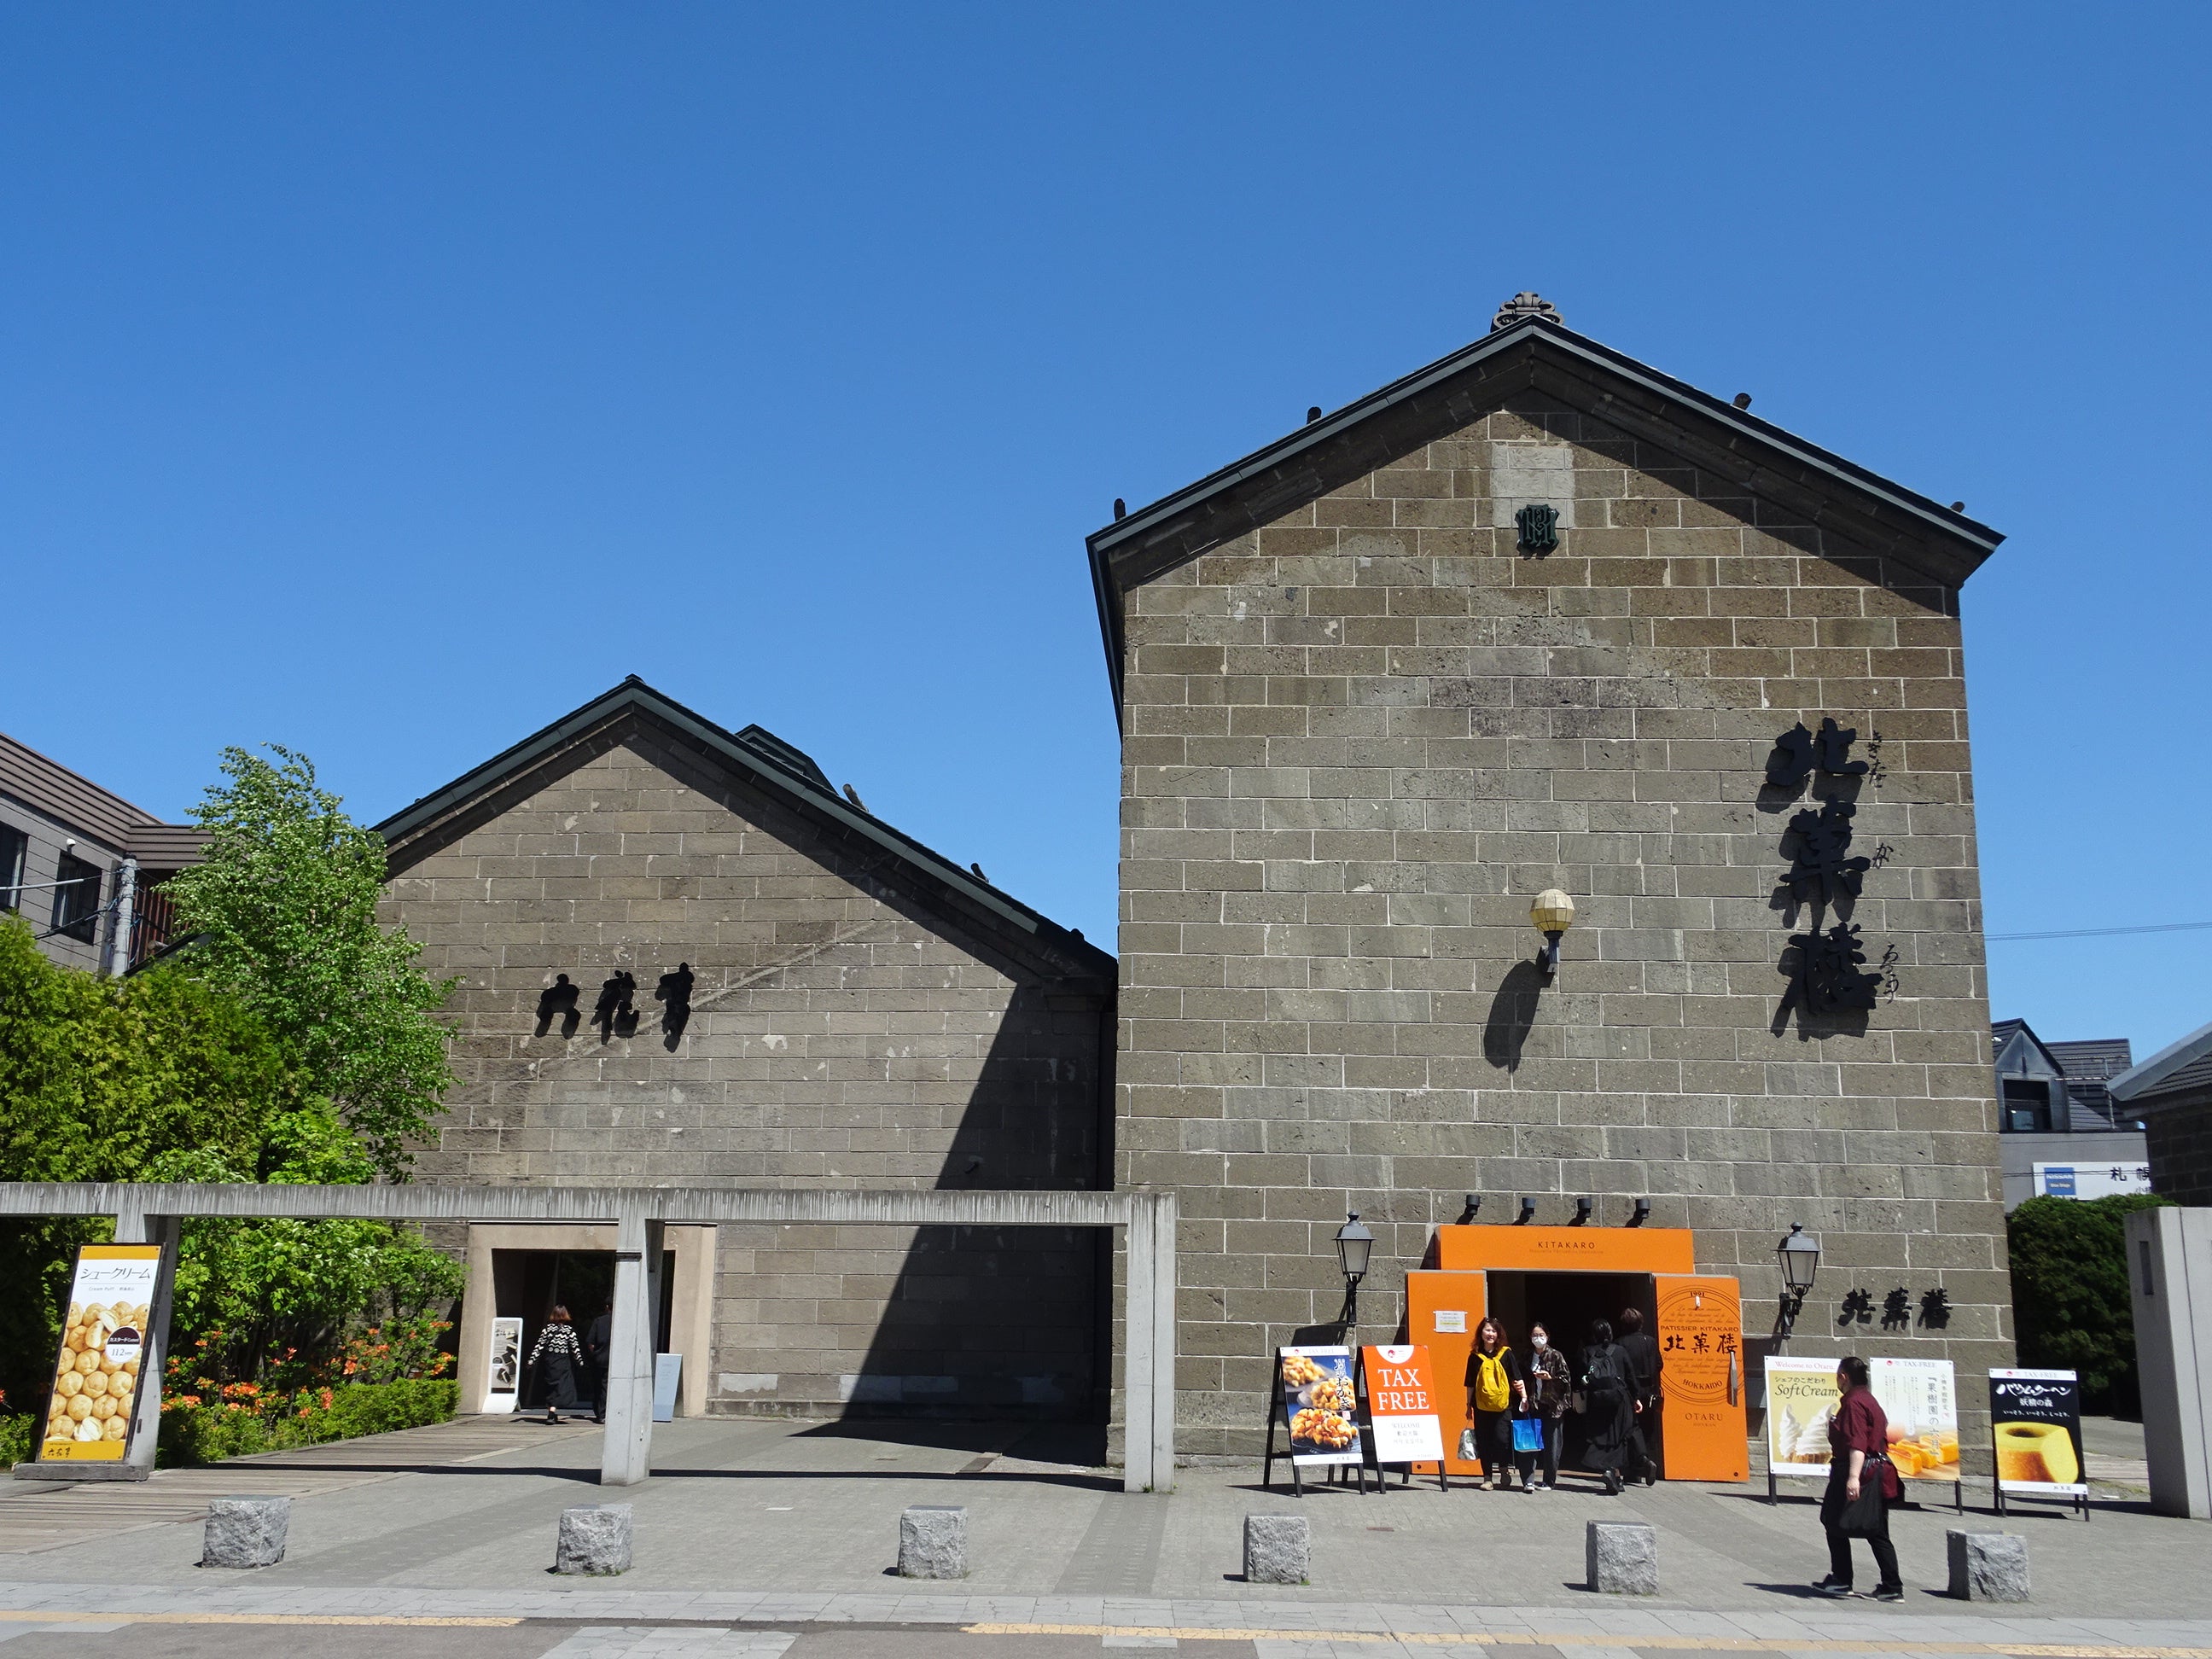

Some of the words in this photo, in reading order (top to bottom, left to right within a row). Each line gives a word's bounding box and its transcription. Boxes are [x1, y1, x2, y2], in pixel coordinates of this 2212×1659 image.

[1538, 1241, 1595, 1249] KITAKARO
[80, 1267, 150, 1280] シュークリーム
[1377, 1369, 1422, 1387] TAX
[1682, 1378, 1723, 1390] HOKKAIDO
[1377, 1391, 1429, 1410] FREE
[1685, 1412, 1723, 1421] OTARU
